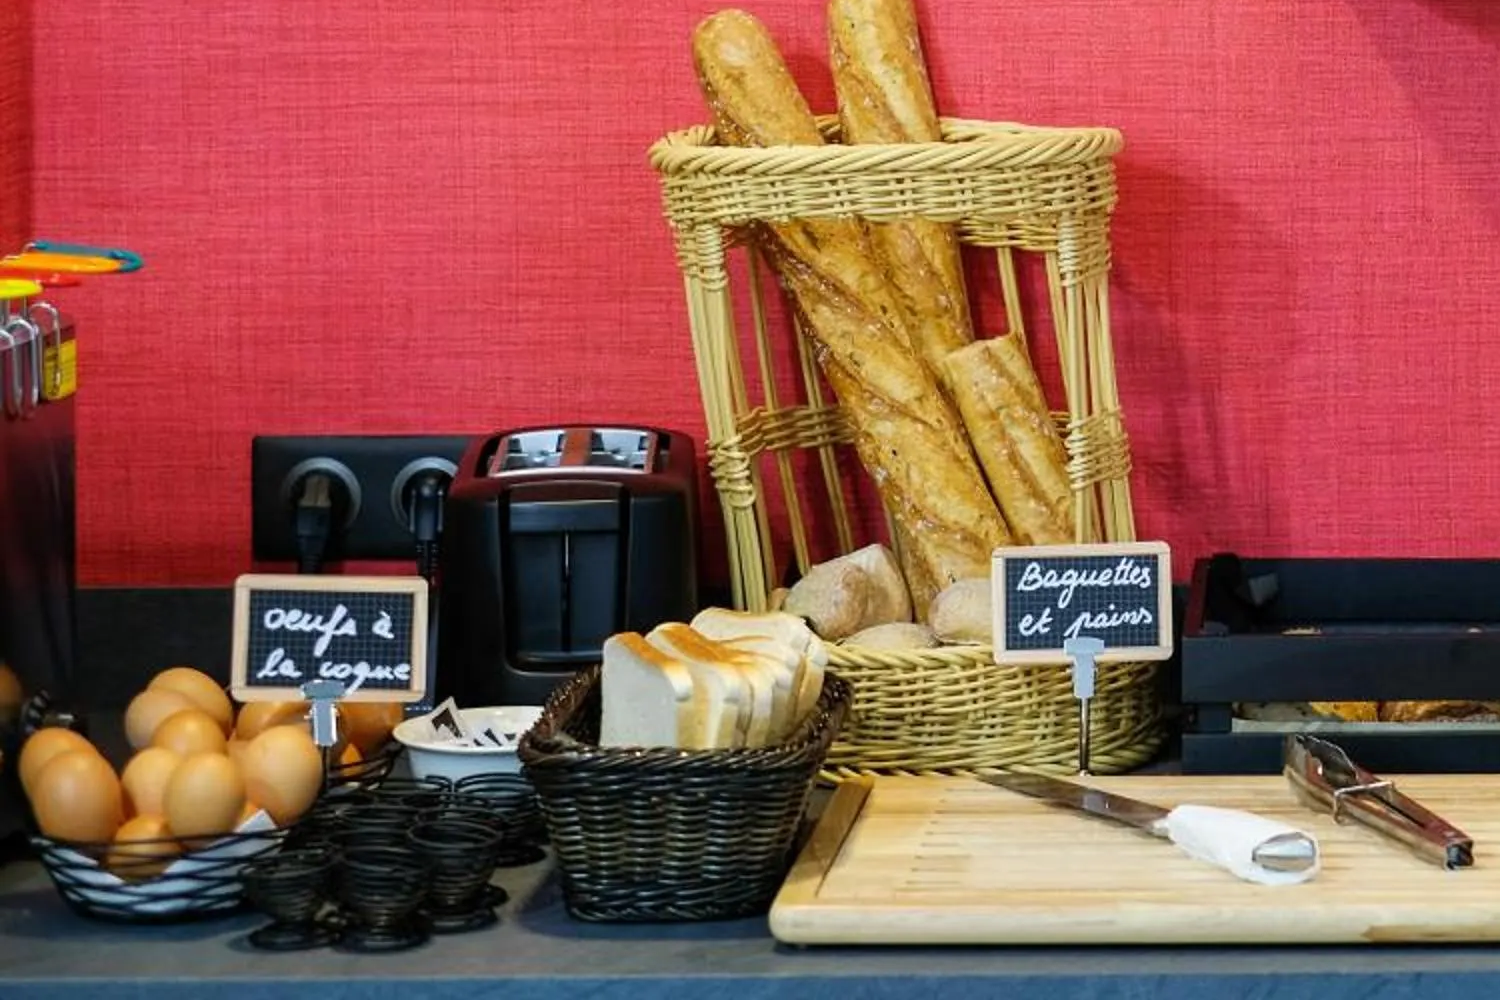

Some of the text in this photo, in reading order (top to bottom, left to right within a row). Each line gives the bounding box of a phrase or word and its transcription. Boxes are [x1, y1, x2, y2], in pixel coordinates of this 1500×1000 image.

[1016, 557, 1152, 609] Baguettes
[371, 610, 395, 639] à
[1018, 604, 1153, 640] et pains
[256, 647, 411, 696] la coque
